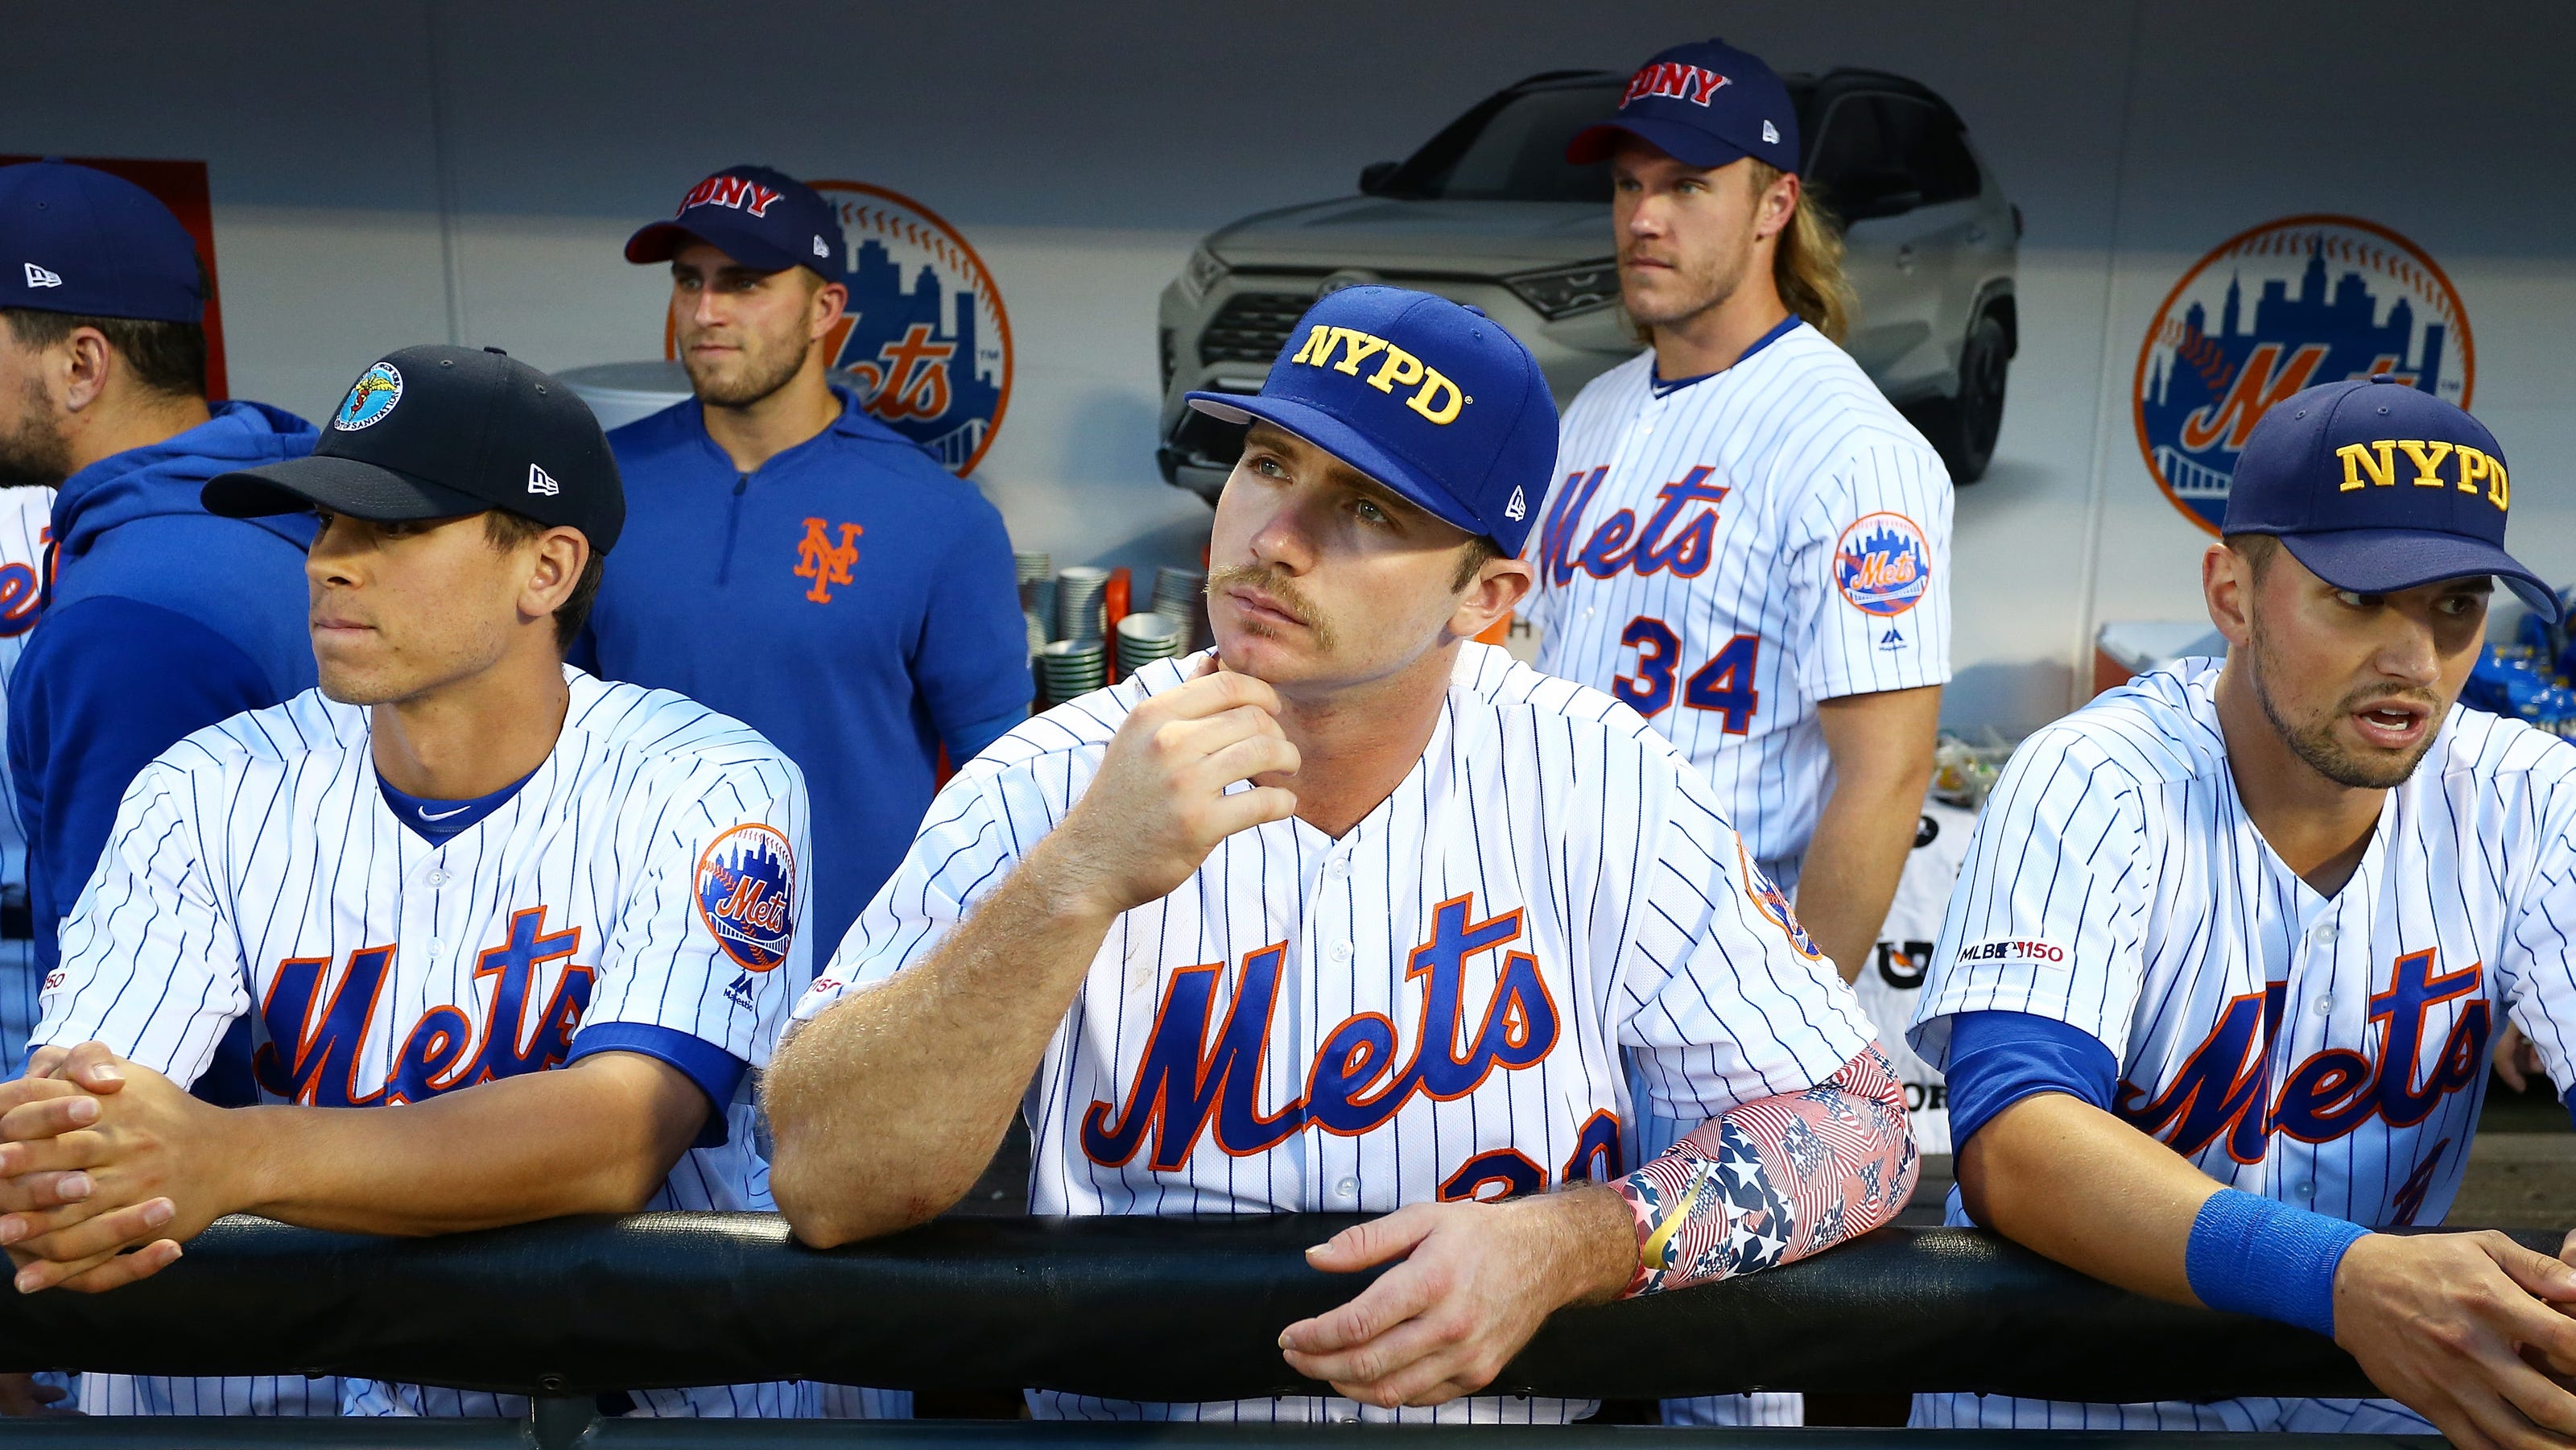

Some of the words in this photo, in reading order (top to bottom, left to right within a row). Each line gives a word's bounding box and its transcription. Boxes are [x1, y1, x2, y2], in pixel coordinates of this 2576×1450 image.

[351, 391, 400, 430] SANITATION
[1291, 324, 1463, 425] NYPD
[2336, 440, 2510, 512] NYPD
[1540, 465, 1732, 593] Mets
[1850, 550, 1918, 589] Mets
[1612, 615, 1761, 735] 34
[715, 874, 787, 934] Mets
[1959, 943, 1995, 963] MLB
[2025, 941, 2064, 962] 150
[253, 904, 596, 1108] Mets
[1080, 890, 1560, 1172] Mets
[2111, 947, 2491, 1165] Mets
